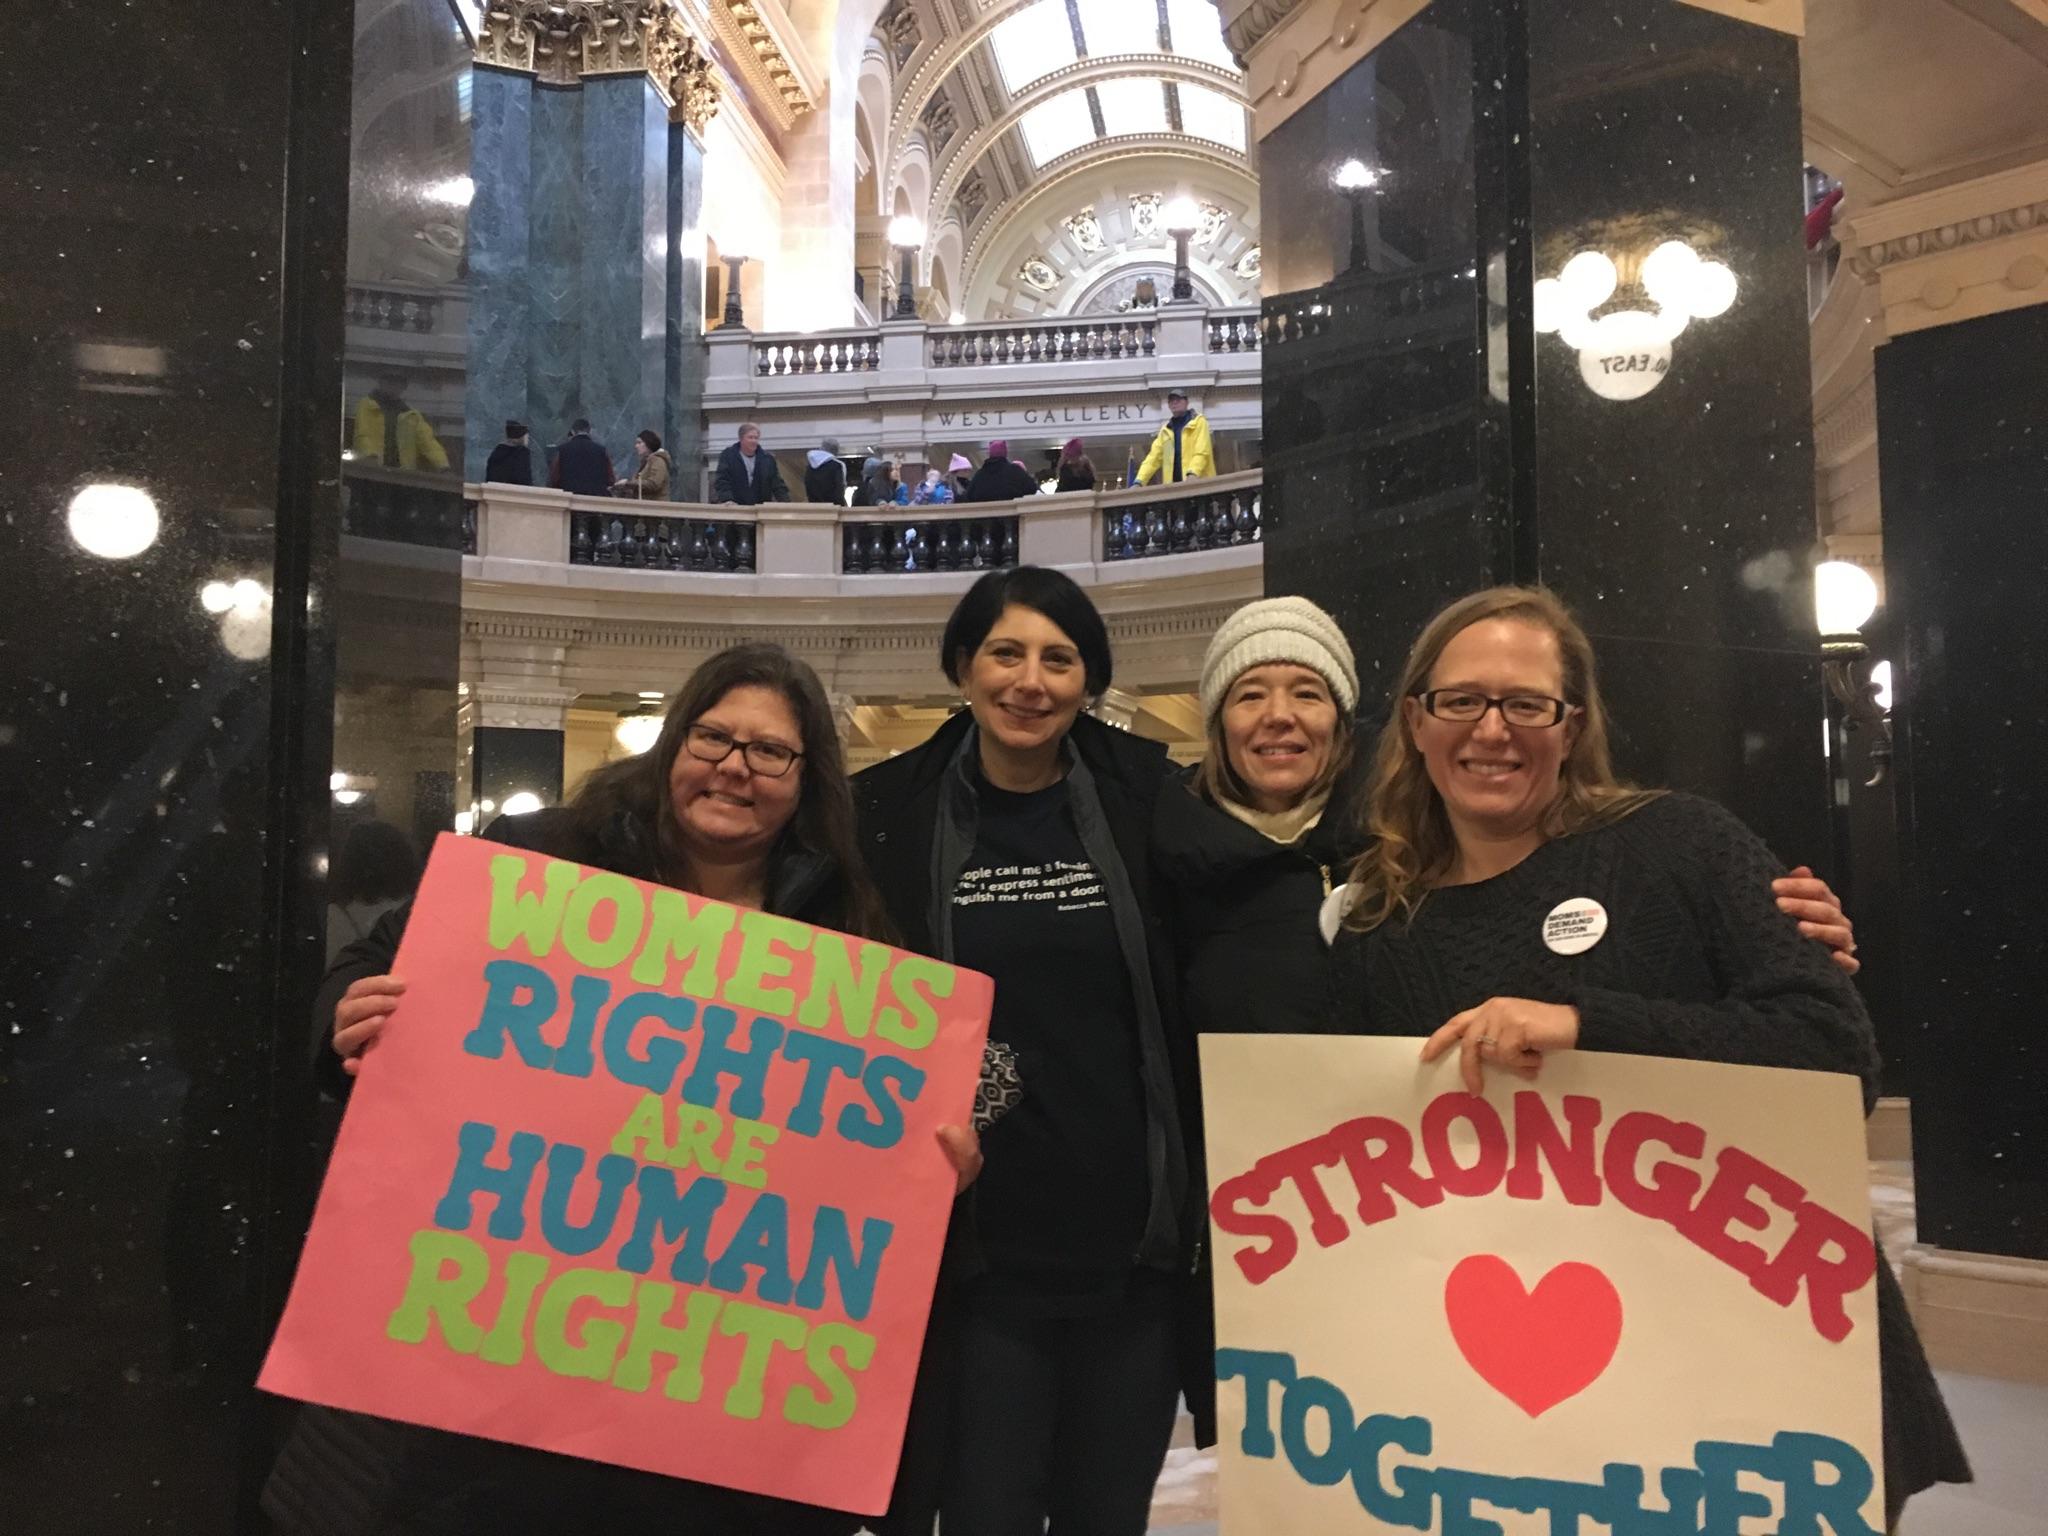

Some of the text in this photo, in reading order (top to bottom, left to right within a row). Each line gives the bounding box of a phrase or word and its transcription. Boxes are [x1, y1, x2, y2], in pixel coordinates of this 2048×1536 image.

[938, 403, 1148, 427] WEST GALLERY
[995, 866, 1018, 876] call
[1022, 866, 1041, 875] me
[1044, 863, 1052, 872] a
[988, 880, 1038, 892] express
[1023, 891, 1055, 901] from
[1547, 917, 1594, 929] DEMAND
[1548, 910, 1581, 921] MOMS
[1547, 925, 1588, 937] ACTION
[489, 854, 955, 1050] WOMENS
[463, 960, 926, 1149] RIGHTS
[611, 1093, 780, 1189] ARE
[434, 1122, 894, 1321] HUMAN
[1209, 1090, 1879, 1343] STRONGER
[387, 1229, 876, 1430] RIGHTS
